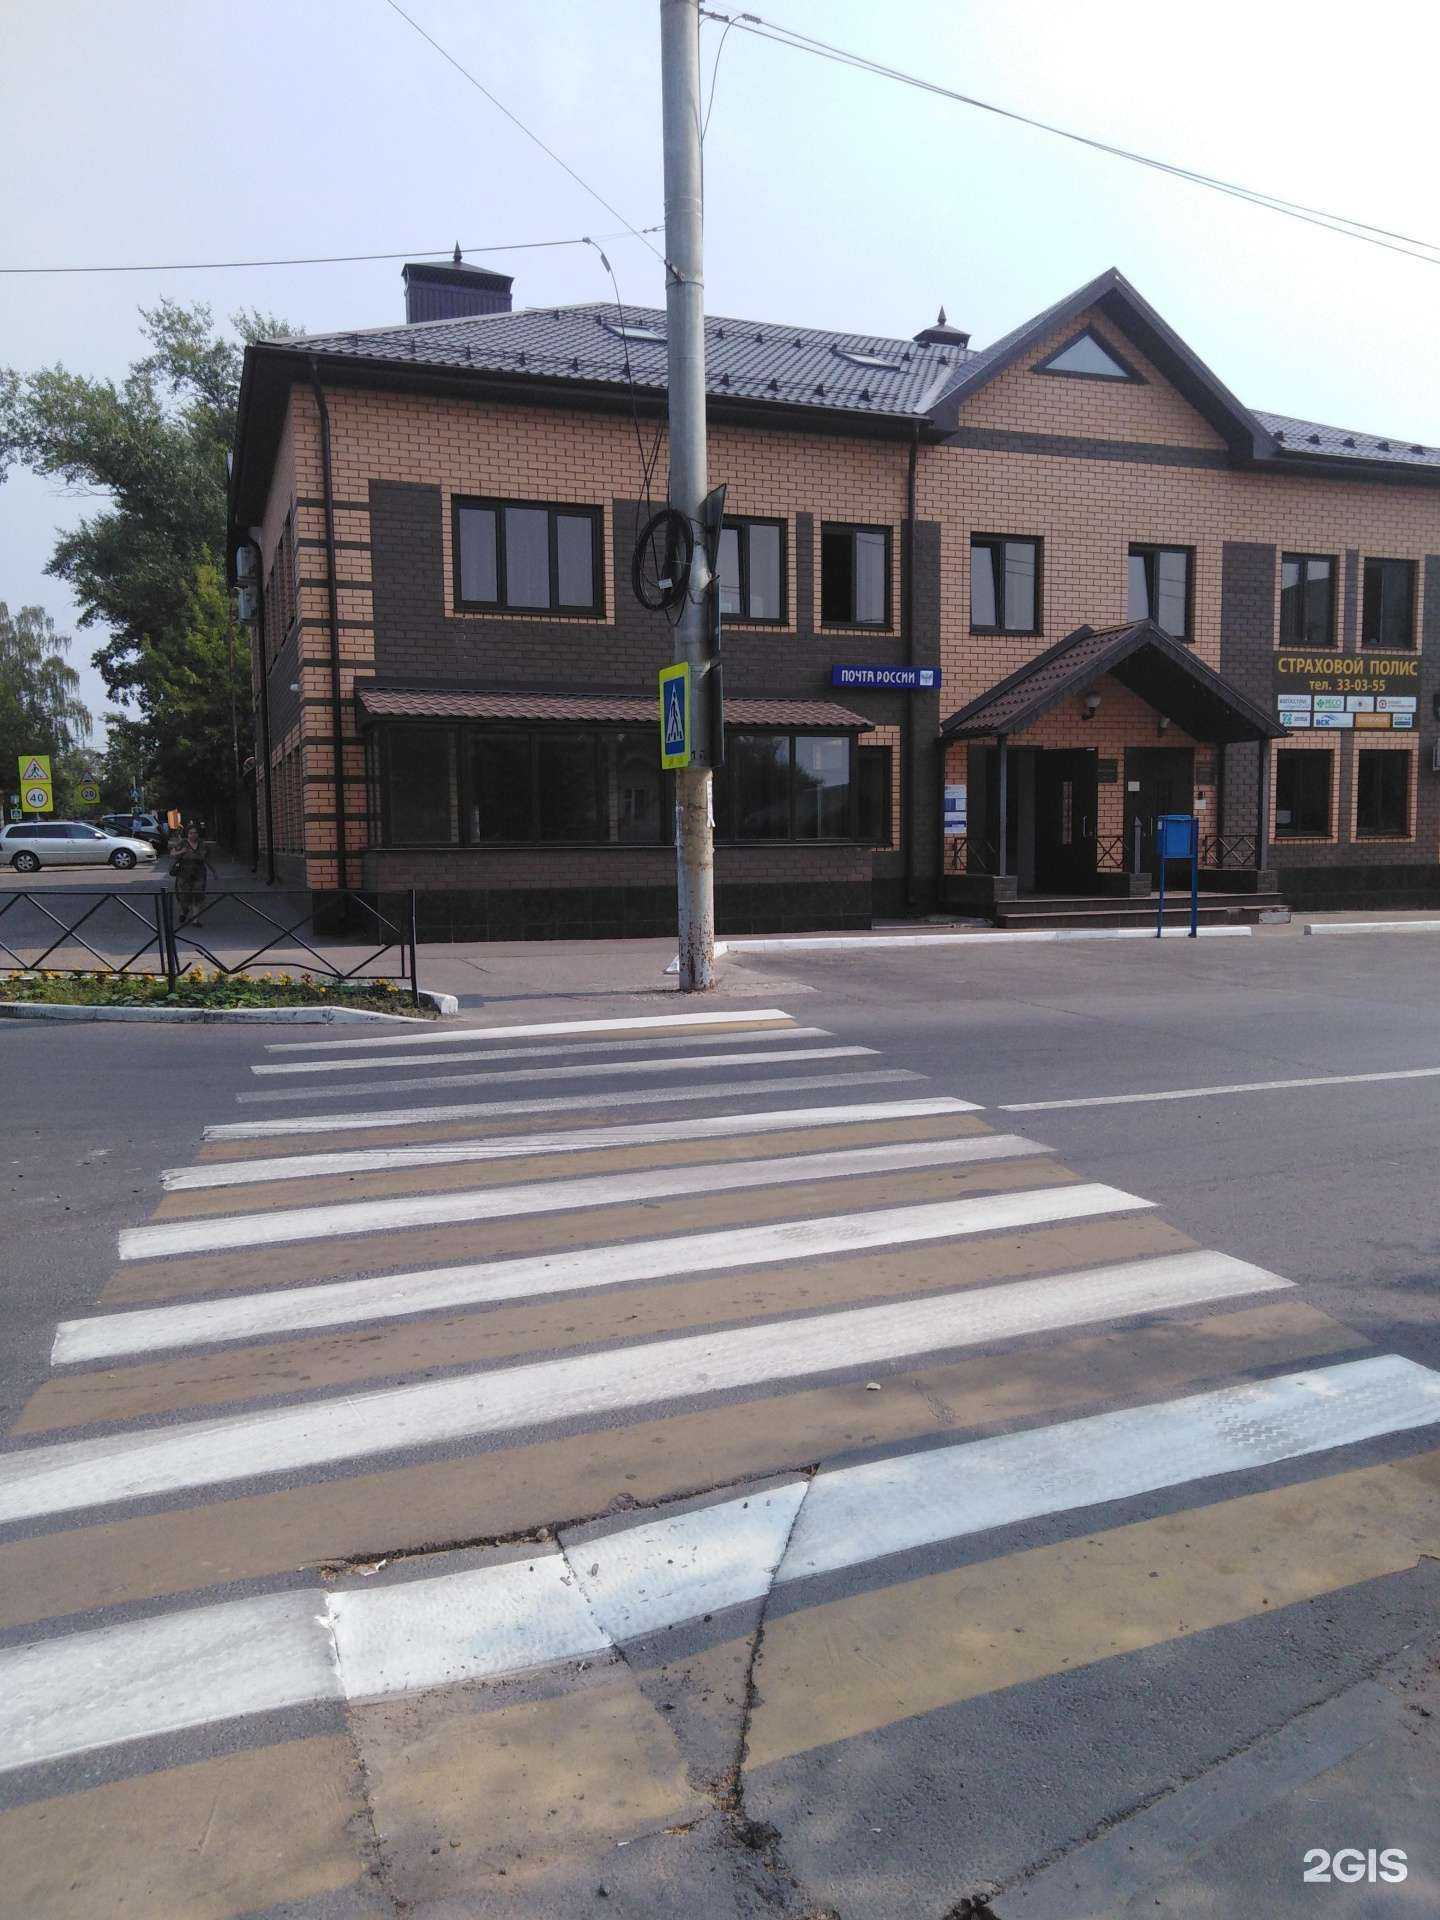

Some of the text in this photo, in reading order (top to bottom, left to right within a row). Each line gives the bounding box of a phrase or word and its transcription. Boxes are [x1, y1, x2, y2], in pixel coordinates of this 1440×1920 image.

[1278, 656, 1418, 676] СТРАХОВОЙ ПОЛИС
[841, 670, 915, 684] ПОЧТА РОССИИ
[1309, 679, 1385, 691] тел. 33-03-55
[29, 793, 44, 801] 40
